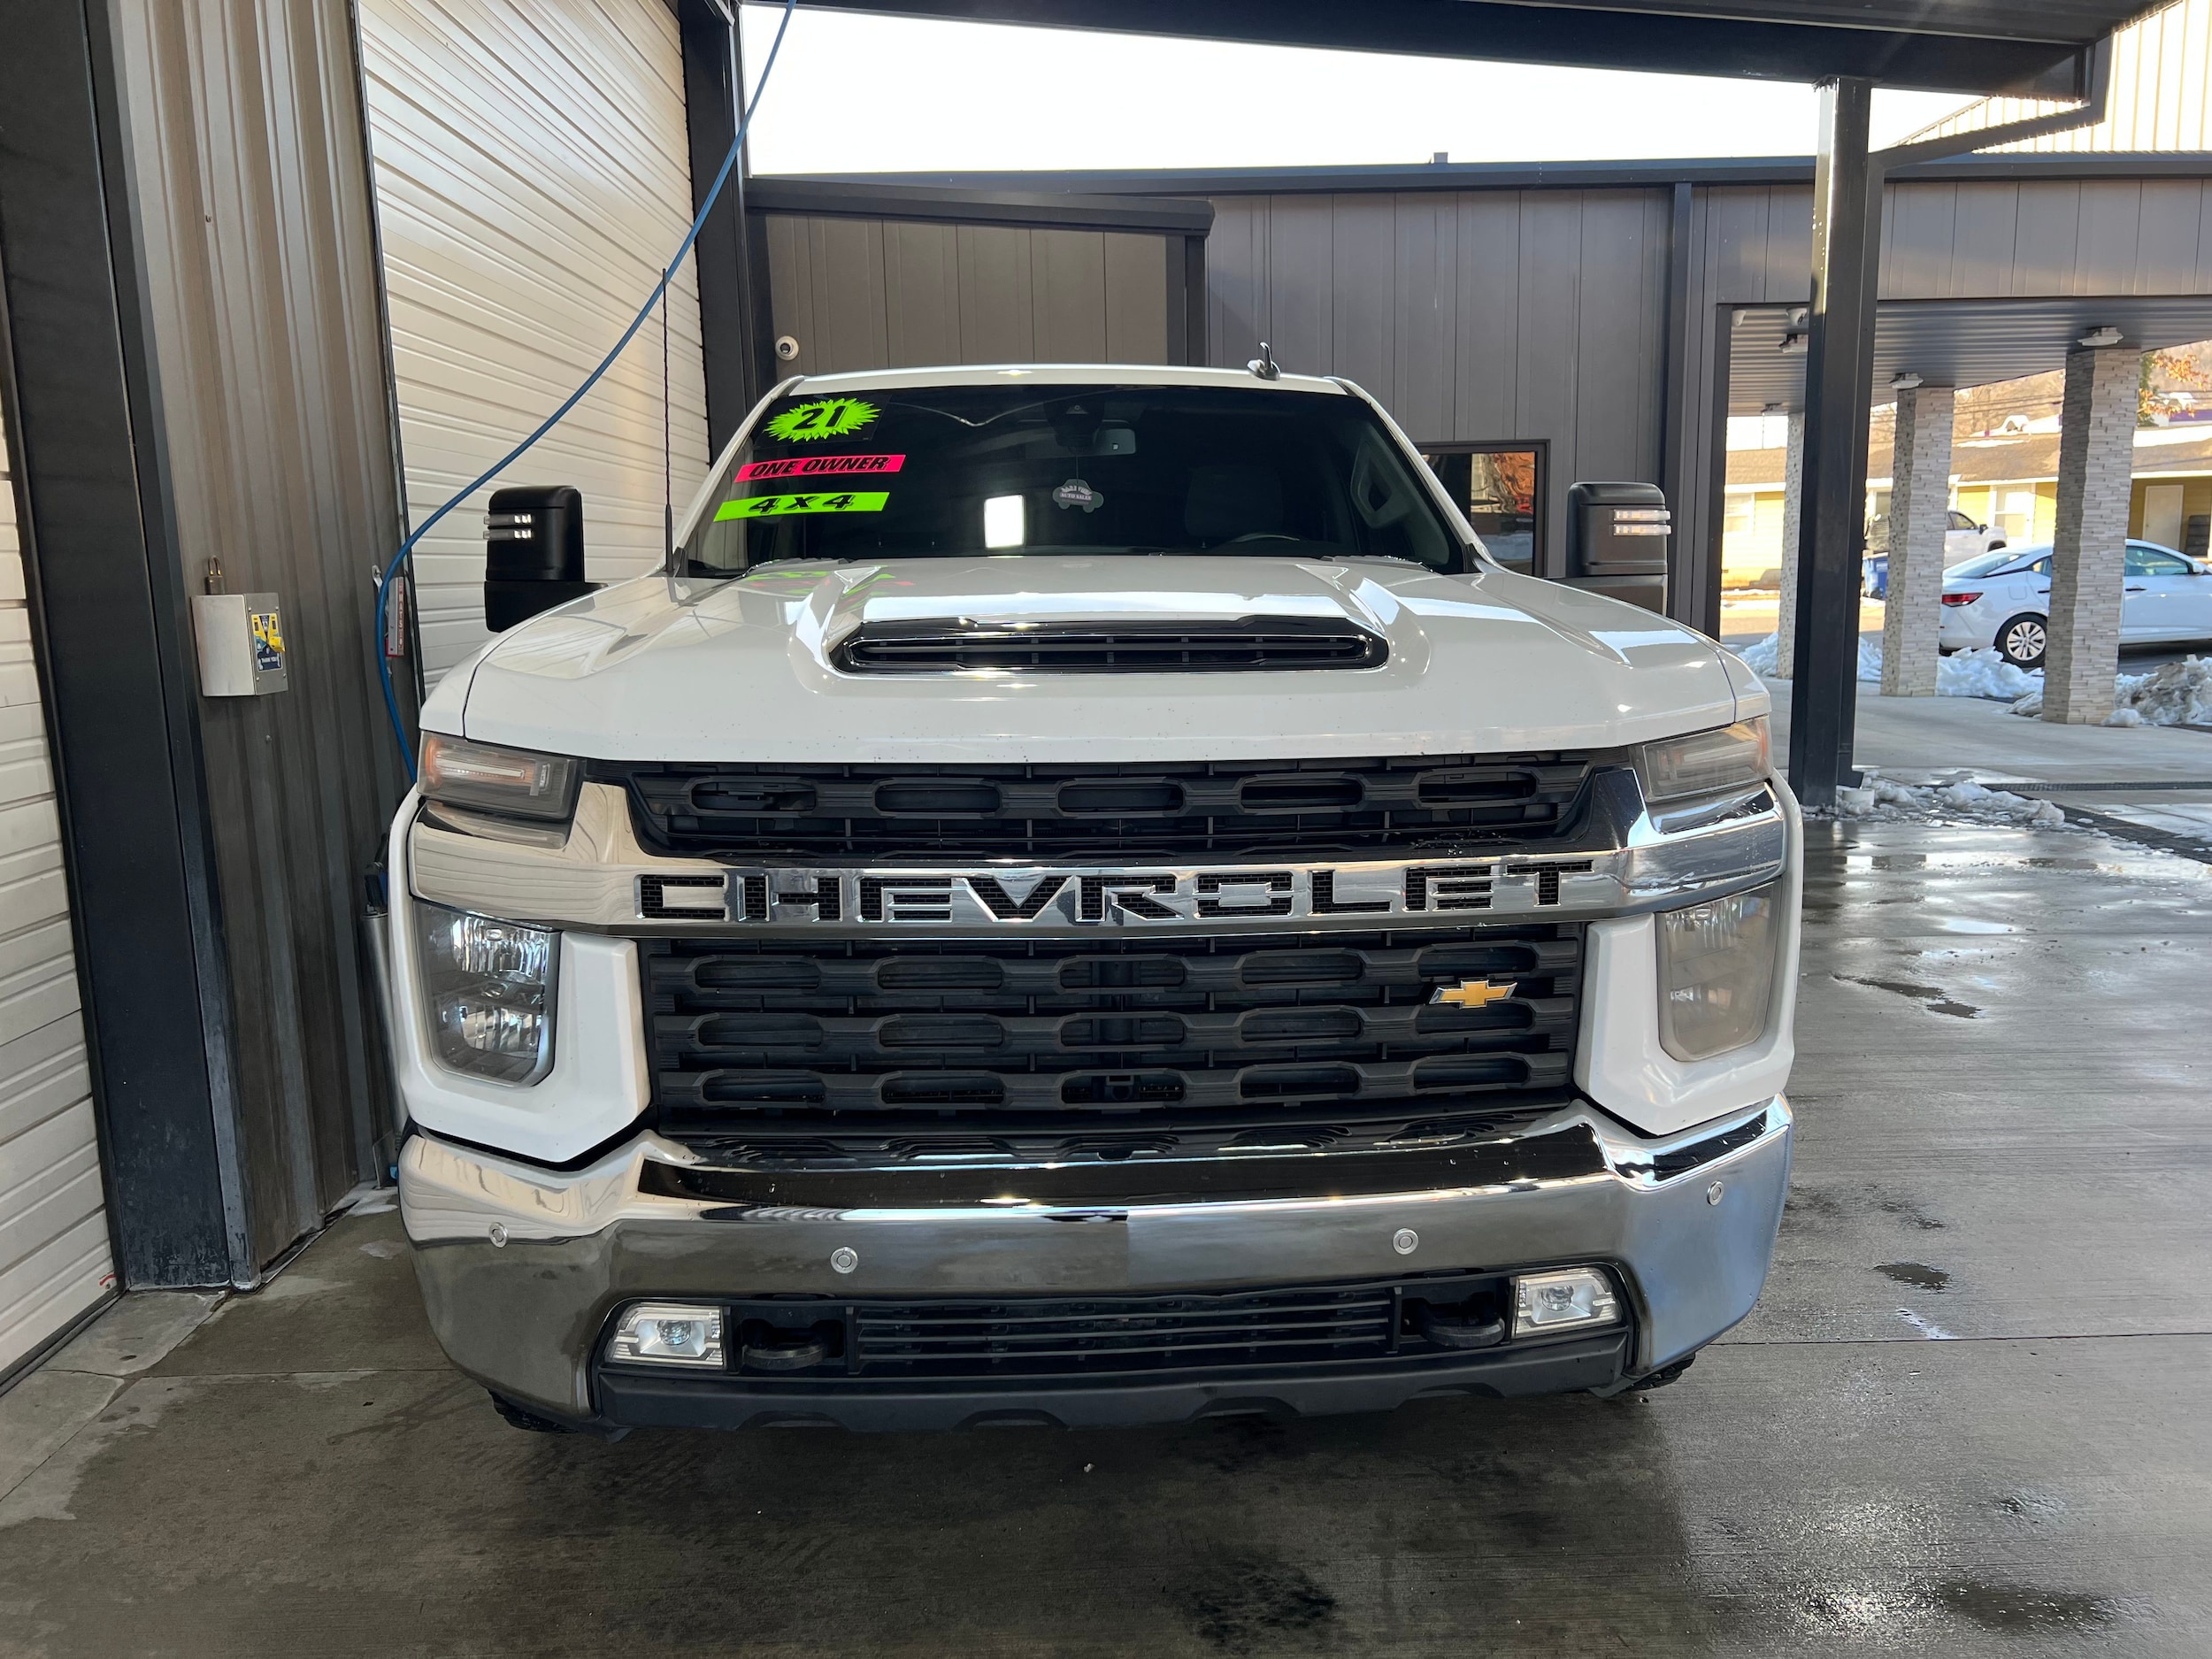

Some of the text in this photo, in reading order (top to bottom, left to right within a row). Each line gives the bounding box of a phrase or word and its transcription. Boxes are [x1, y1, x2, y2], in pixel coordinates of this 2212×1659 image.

[792, 405, 847, 430] 21
[749, 457, 891, 479] ONE OWNER
[636, 860, 1594, 922] CHEVROLET
